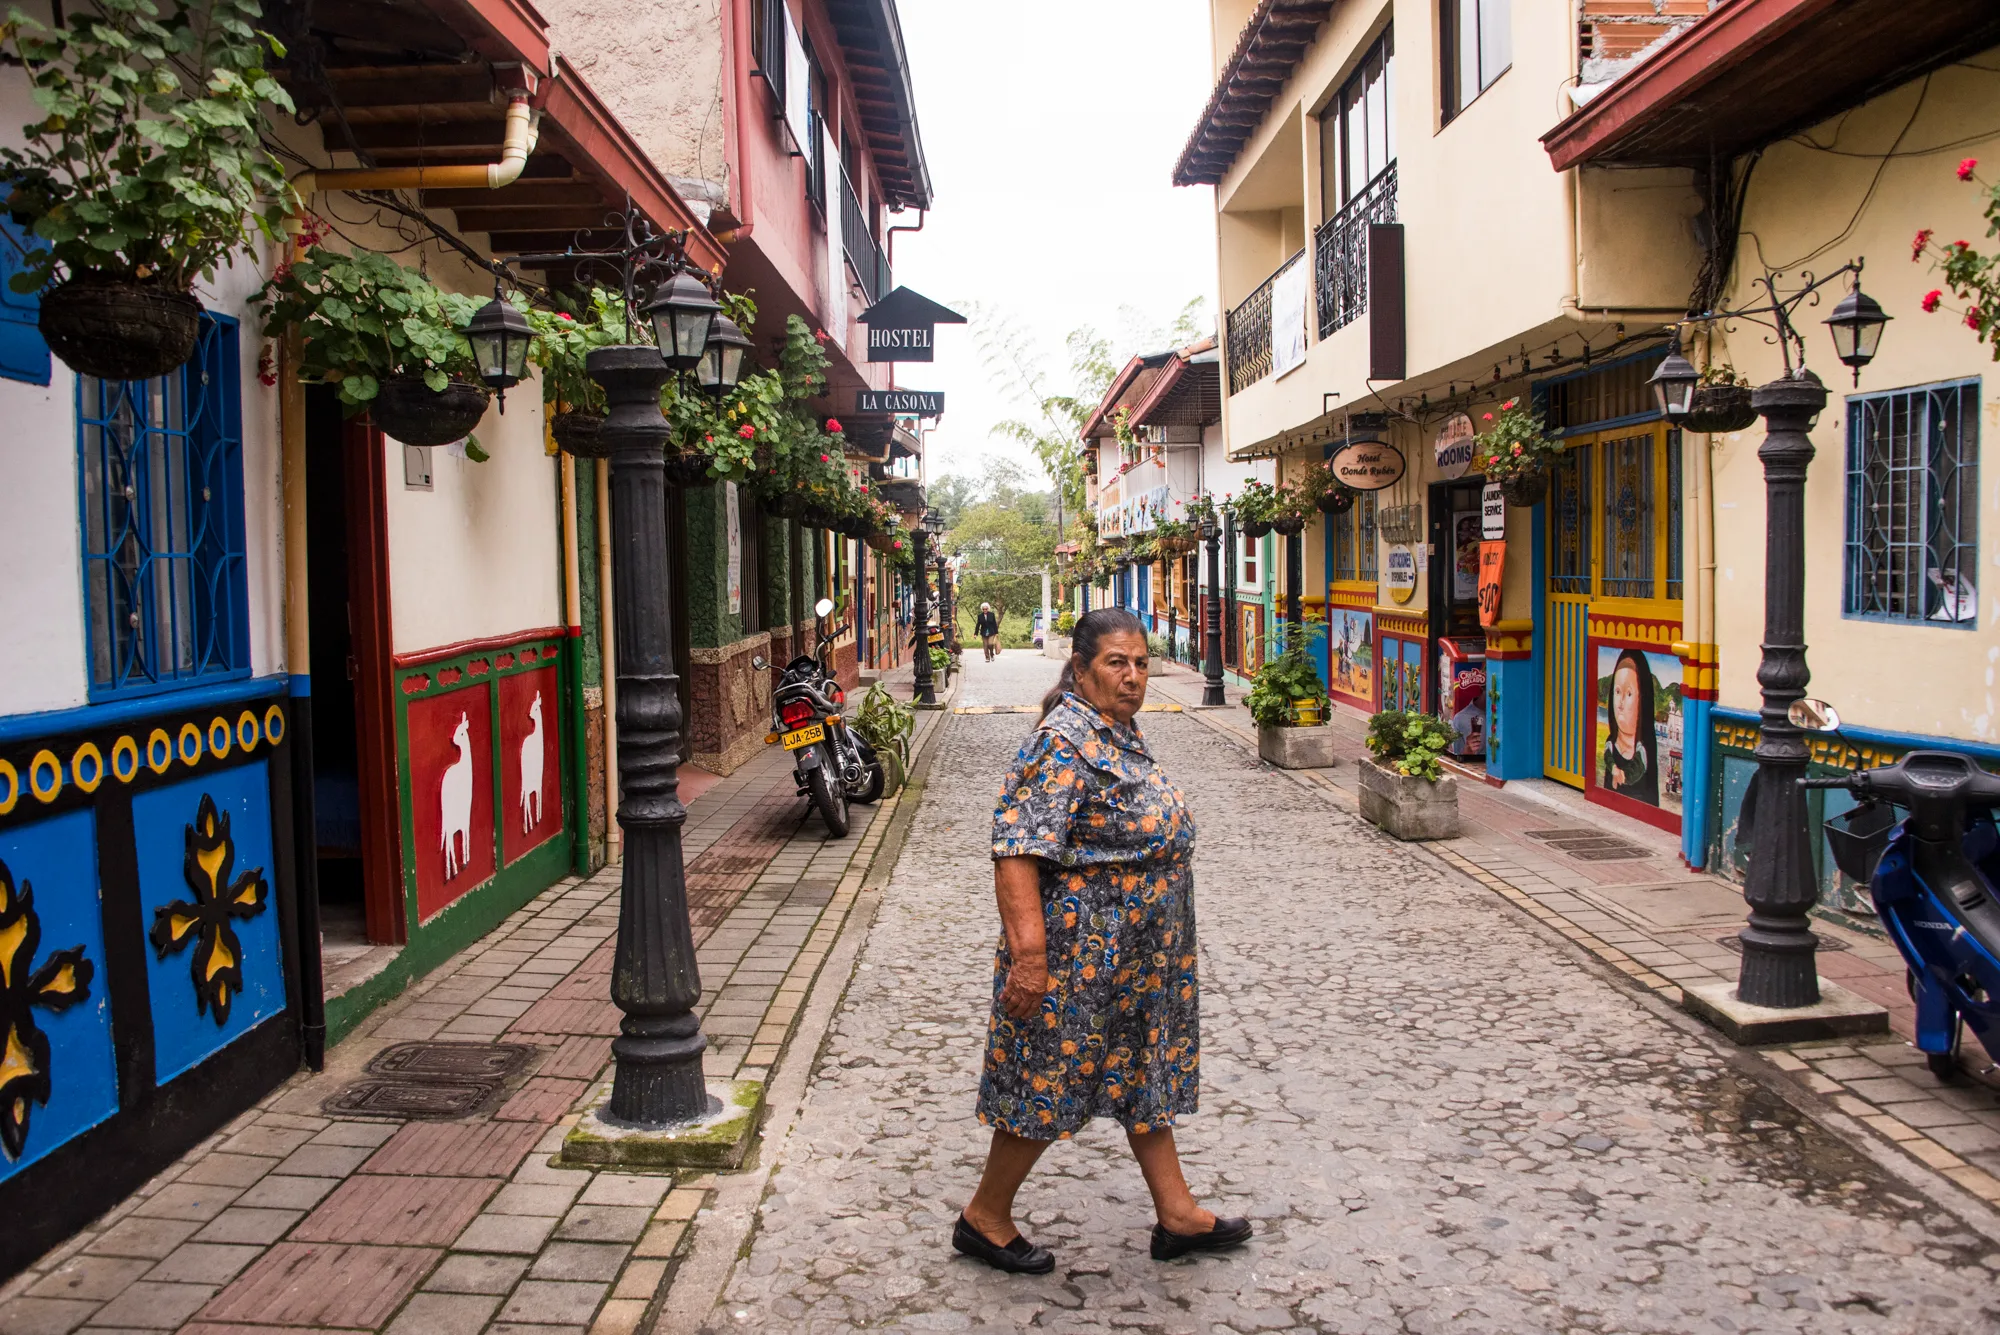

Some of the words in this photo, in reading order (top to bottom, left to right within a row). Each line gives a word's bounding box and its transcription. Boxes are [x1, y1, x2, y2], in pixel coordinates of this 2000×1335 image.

[870, 329, 931, 347] HOSTEL
[862, 394, 878, 410] LA
[885, 394, 936, 411] CASONA
[1437, 445, 1471, 468] ROOMS
[1341, 466, 1368, 476] Donde
[783, 733, 802, 747] LJA
[804, 727, 822, 740] 25B
[1913, 920, 1953, 930] HONDA
